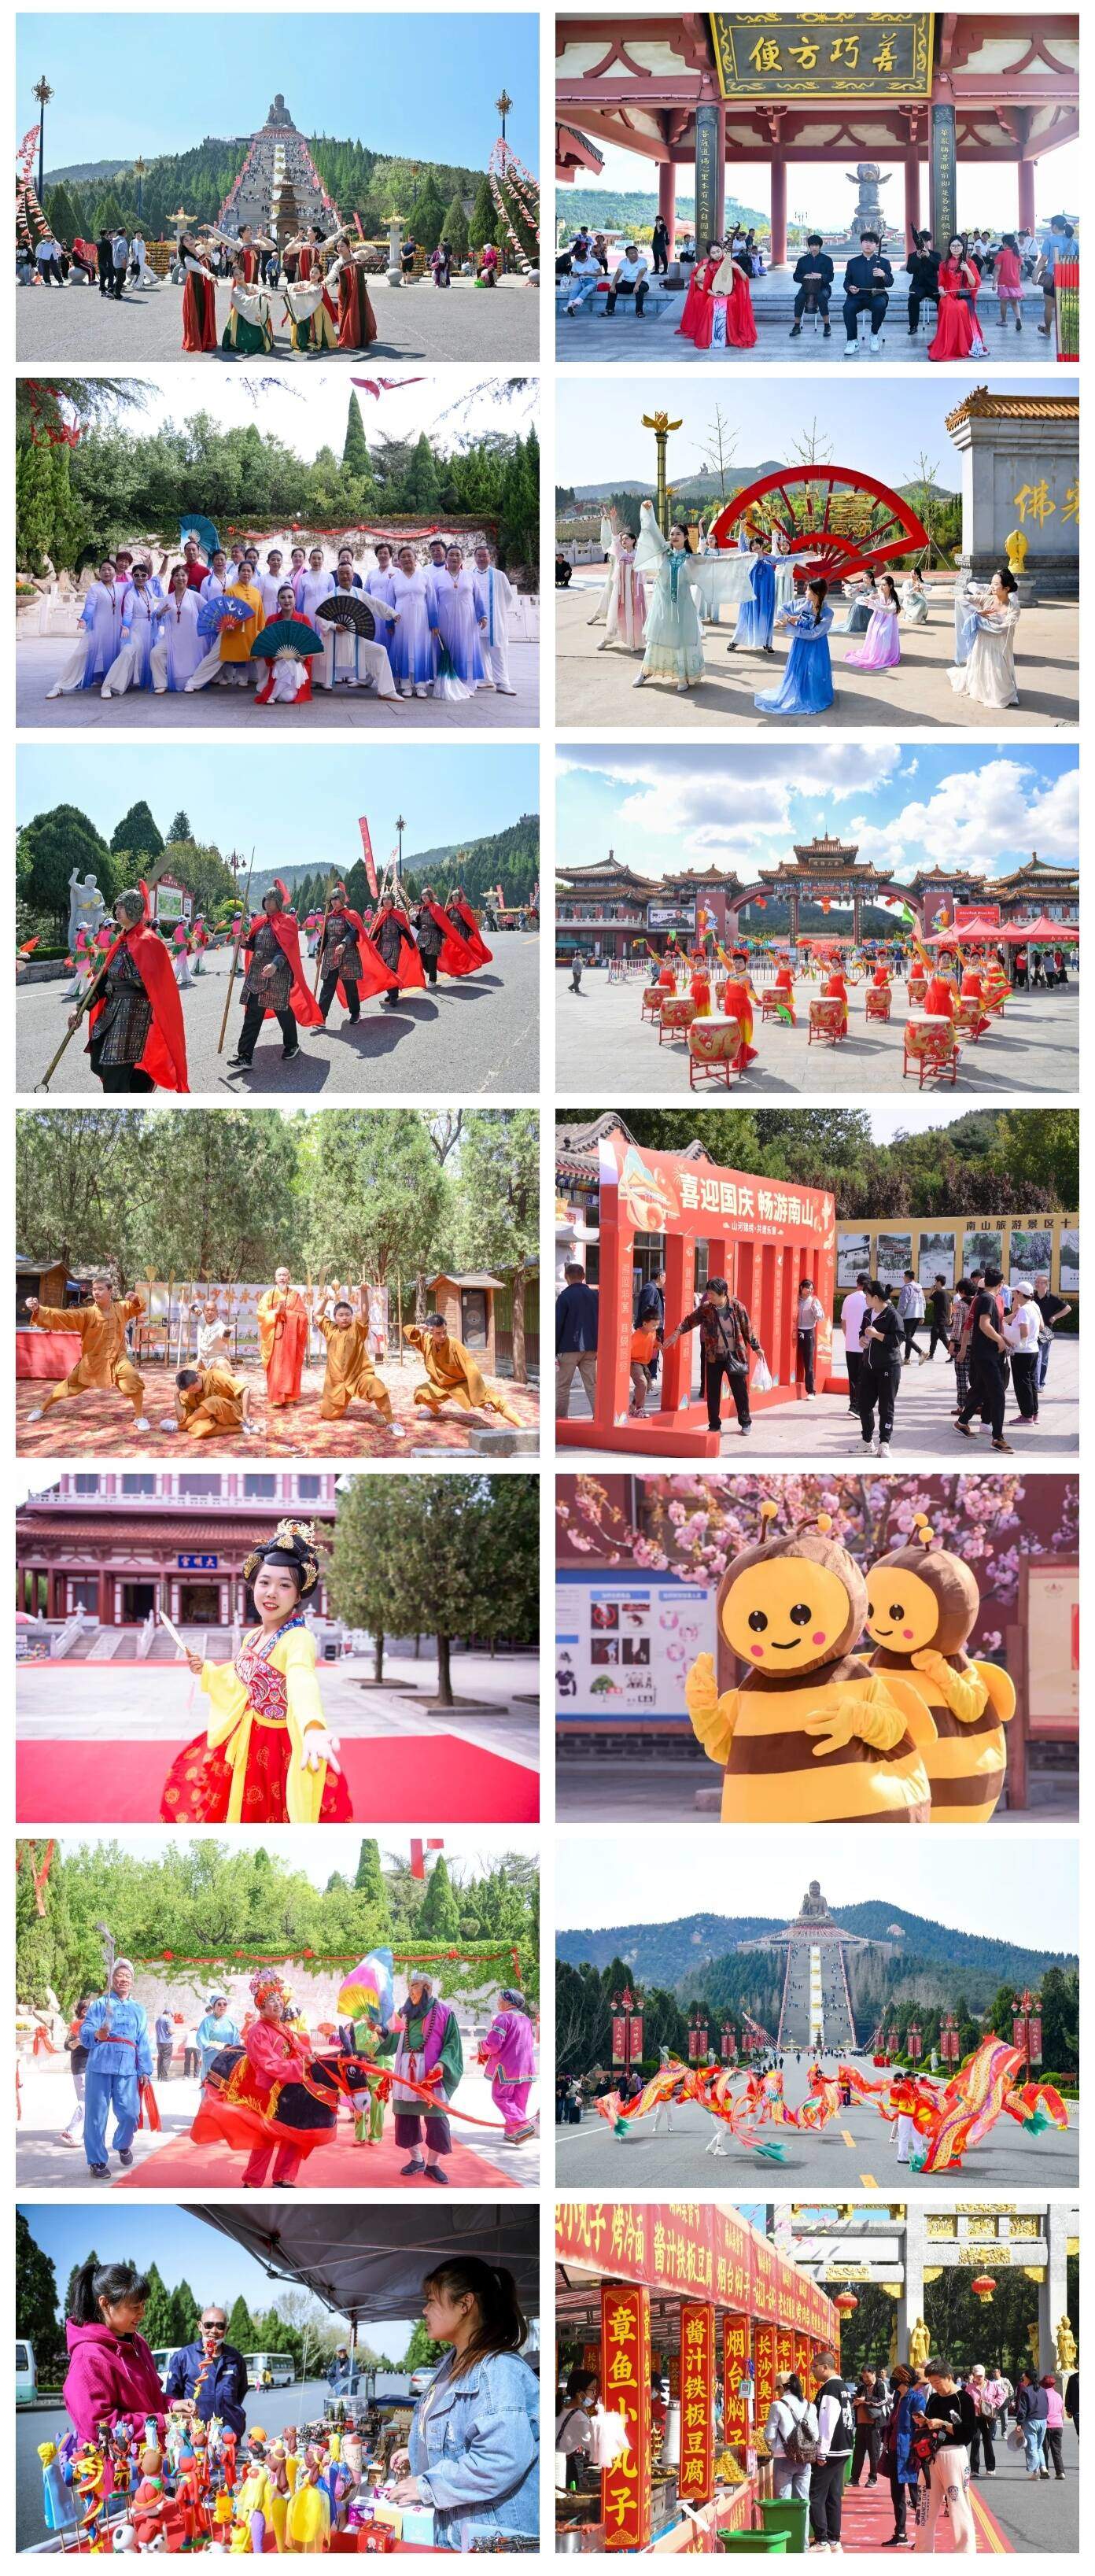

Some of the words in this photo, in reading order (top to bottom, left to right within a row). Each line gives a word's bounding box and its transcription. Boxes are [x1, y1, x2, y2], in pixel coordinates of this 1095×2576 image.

[680, 1172, 755, 1218] 喜迎国庆
[758, 1187, 813, 1228] 畅游南山
[966, 1218, 1080, 1231] 南山旅游景区十
[654, 2222, 713, 2287] 酱汁铁板豆腐
[717, 2256, 750, 2302] 烟台焖子
[605, 2305, 638, 2527] 章鱼小丸子
[683, 2319, 709, 2486] 酱汁铁板豆腐
